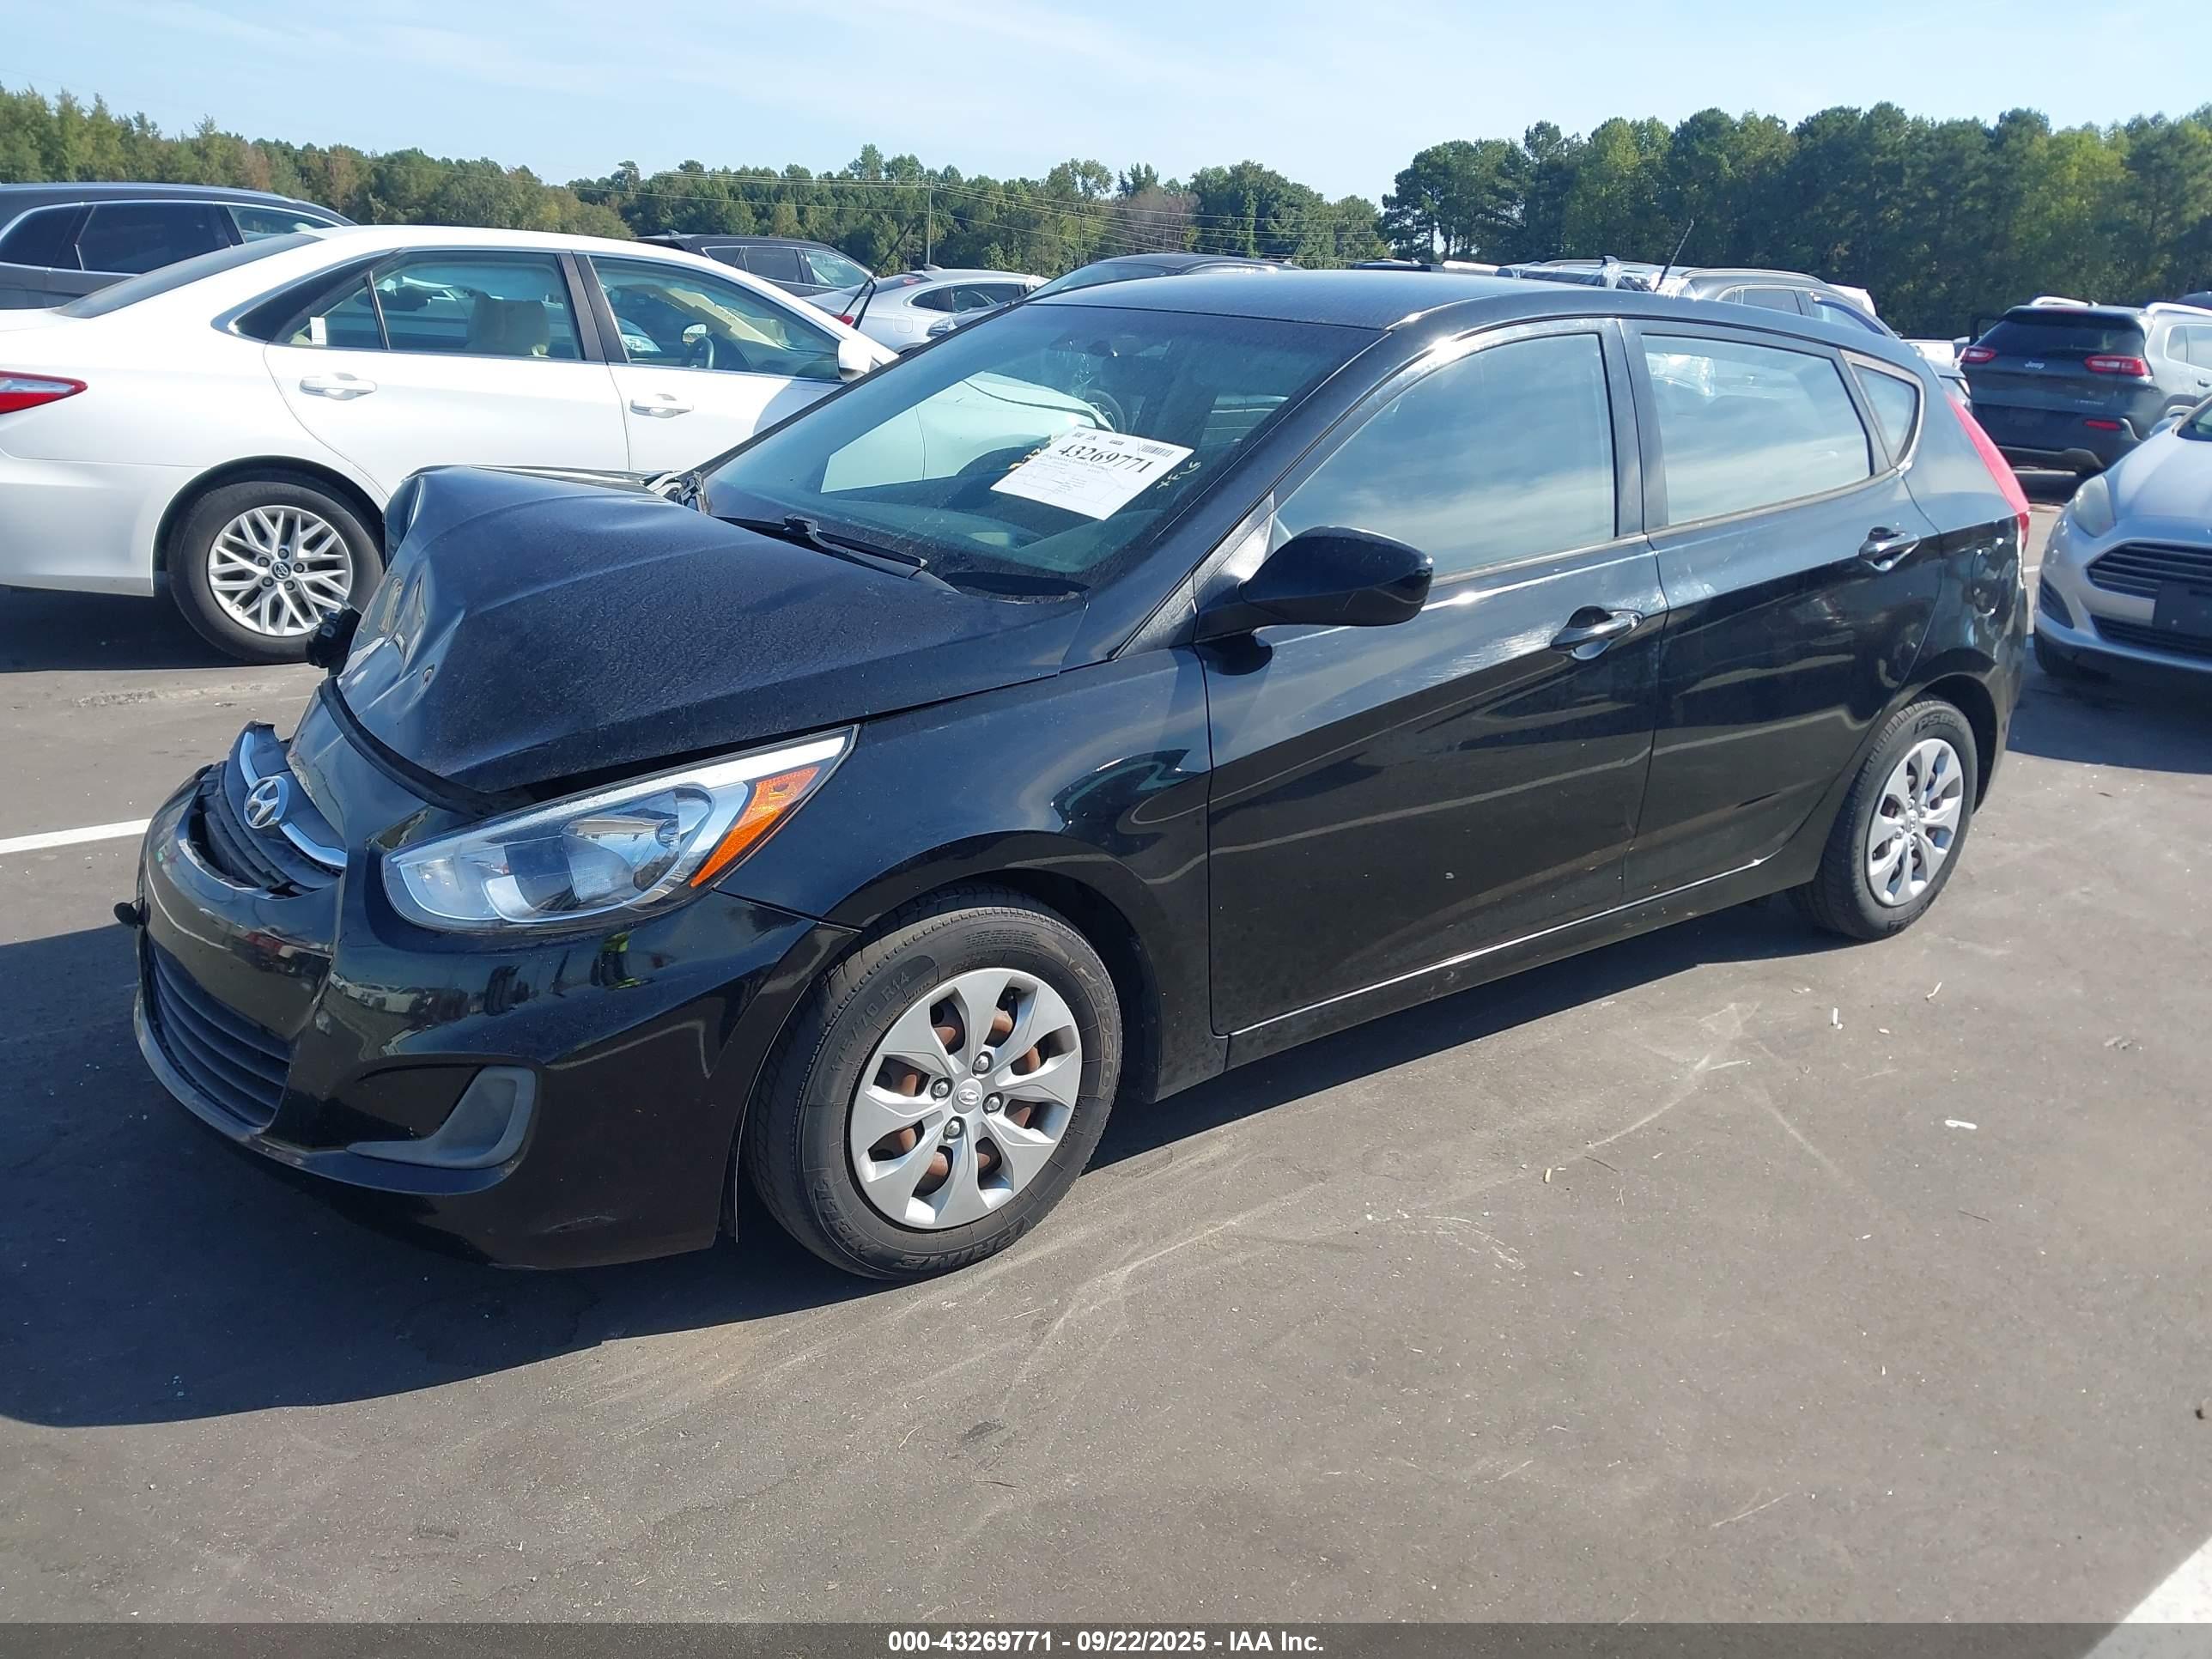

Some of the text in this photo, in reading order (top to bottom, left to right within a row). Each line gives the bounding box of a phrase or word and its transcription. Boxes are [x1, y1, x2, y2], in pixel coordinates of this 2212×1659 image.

[2024, 361, 2046, 371] Jeep
[1058, 443, 1155, 473] 43269771
[830, 968, 911, 1073] 175/70 R14
